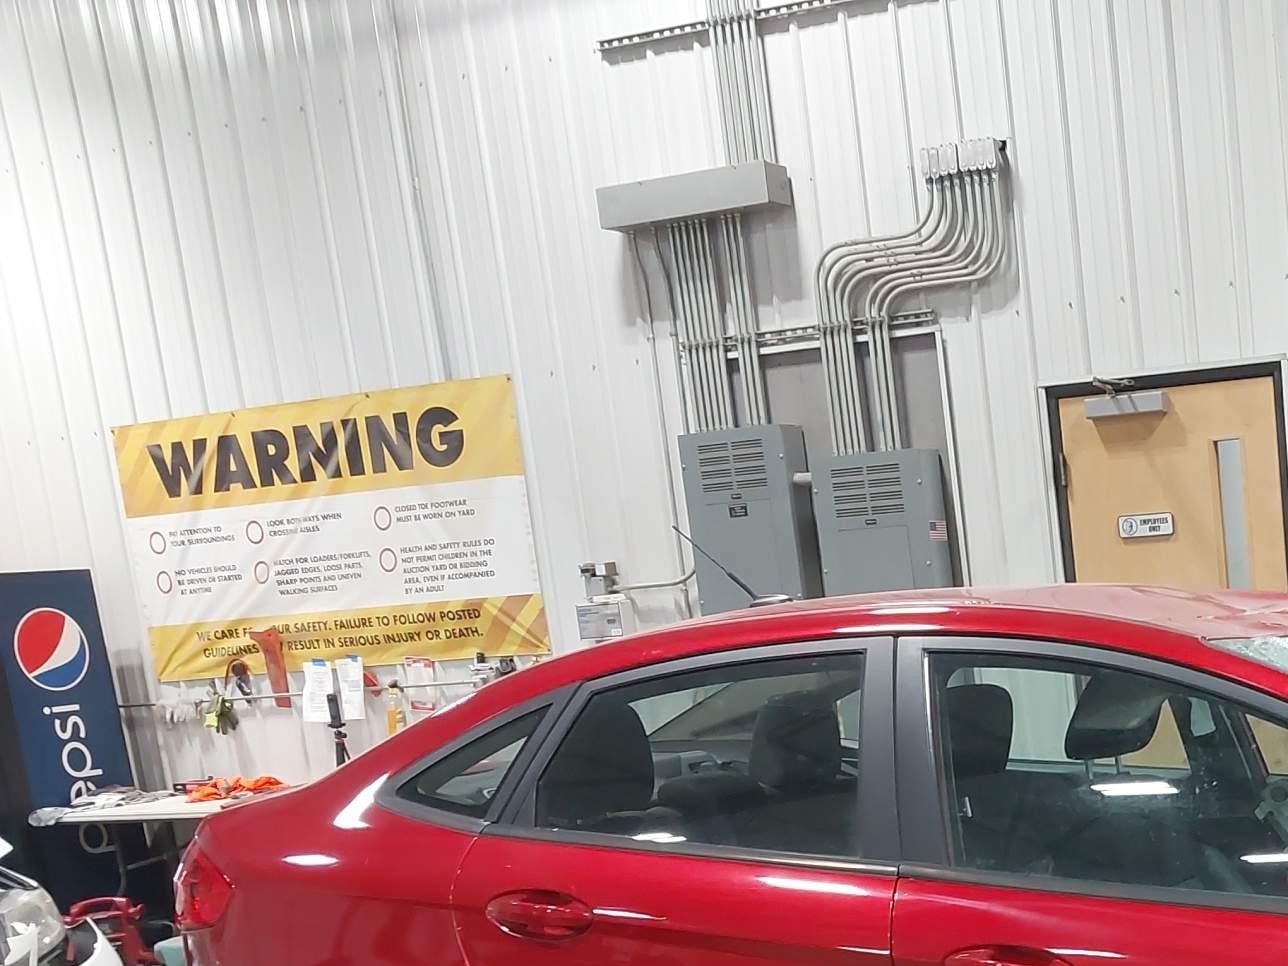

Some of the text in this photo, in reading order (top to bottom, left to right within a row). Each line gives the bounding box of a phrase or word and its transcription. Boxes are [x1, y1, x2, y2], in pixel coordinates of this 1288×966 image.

[147, 406, 465, 498] WARNING
[395, 505, 417, 513] CLOSED
[430, 499, 467, 509] FOOTWEAR
[423, 512, 443, 520] WORN
[457, 509, 475, 517] YARD
[1140, 517, 1168, 526] EMPLOYEES
[179, 527, 212, 536] ATTENTION
[300, 525, 320, 533] AISLES
[187, 535, 235, 546] SURROUNDINGS
[400, 545, 423, 554] HEALTH
[439, 541, 460, 550] SAFETY
[463, 540, 481, 548] RULES
[438, 550, 468, 560] CHILDREN
[188, 567, 213, 575] VEHICLES
[213, 564, 237, 572] SHOULD
[274, 568, 299, 576] JAGGED
[323, 564, 343, 572] LOOSE
[403, 565, 430, 574] AUCTION
[432, 563, 447, 571] YARD
[460, 560, 488, 568] BIDDING
[187, 577, 207, 585] DRIVEN
[218, 574, 242, 582] STARTED
[276, 578, 298, 586] SHARP
[299, 576, 322, 584] POINTS
[338, 572, 361, 580] UNEVEN
[447, 570, 495, 580] ACCOMPANIED
[278, 585, 338, 596] WALKING SURFACES
[272, 608, 481, 634] OUR SAFETY. FAILURE TO FOLLOW POSTED
[196, 630, 212, 641] WE
[213, 628, 241, 640] CARE
[287, 638, 320, 652] RESULT
[323, 637, 336, 649] IN
[338, 634, 382, 647] SERIOUS
[383, 630, 422, 644] INJURY
[425, 629, 442, 641] OR
[444, 626, 484, 639] DEATH.
[203, 644, 260, 658] GUIDELINES
